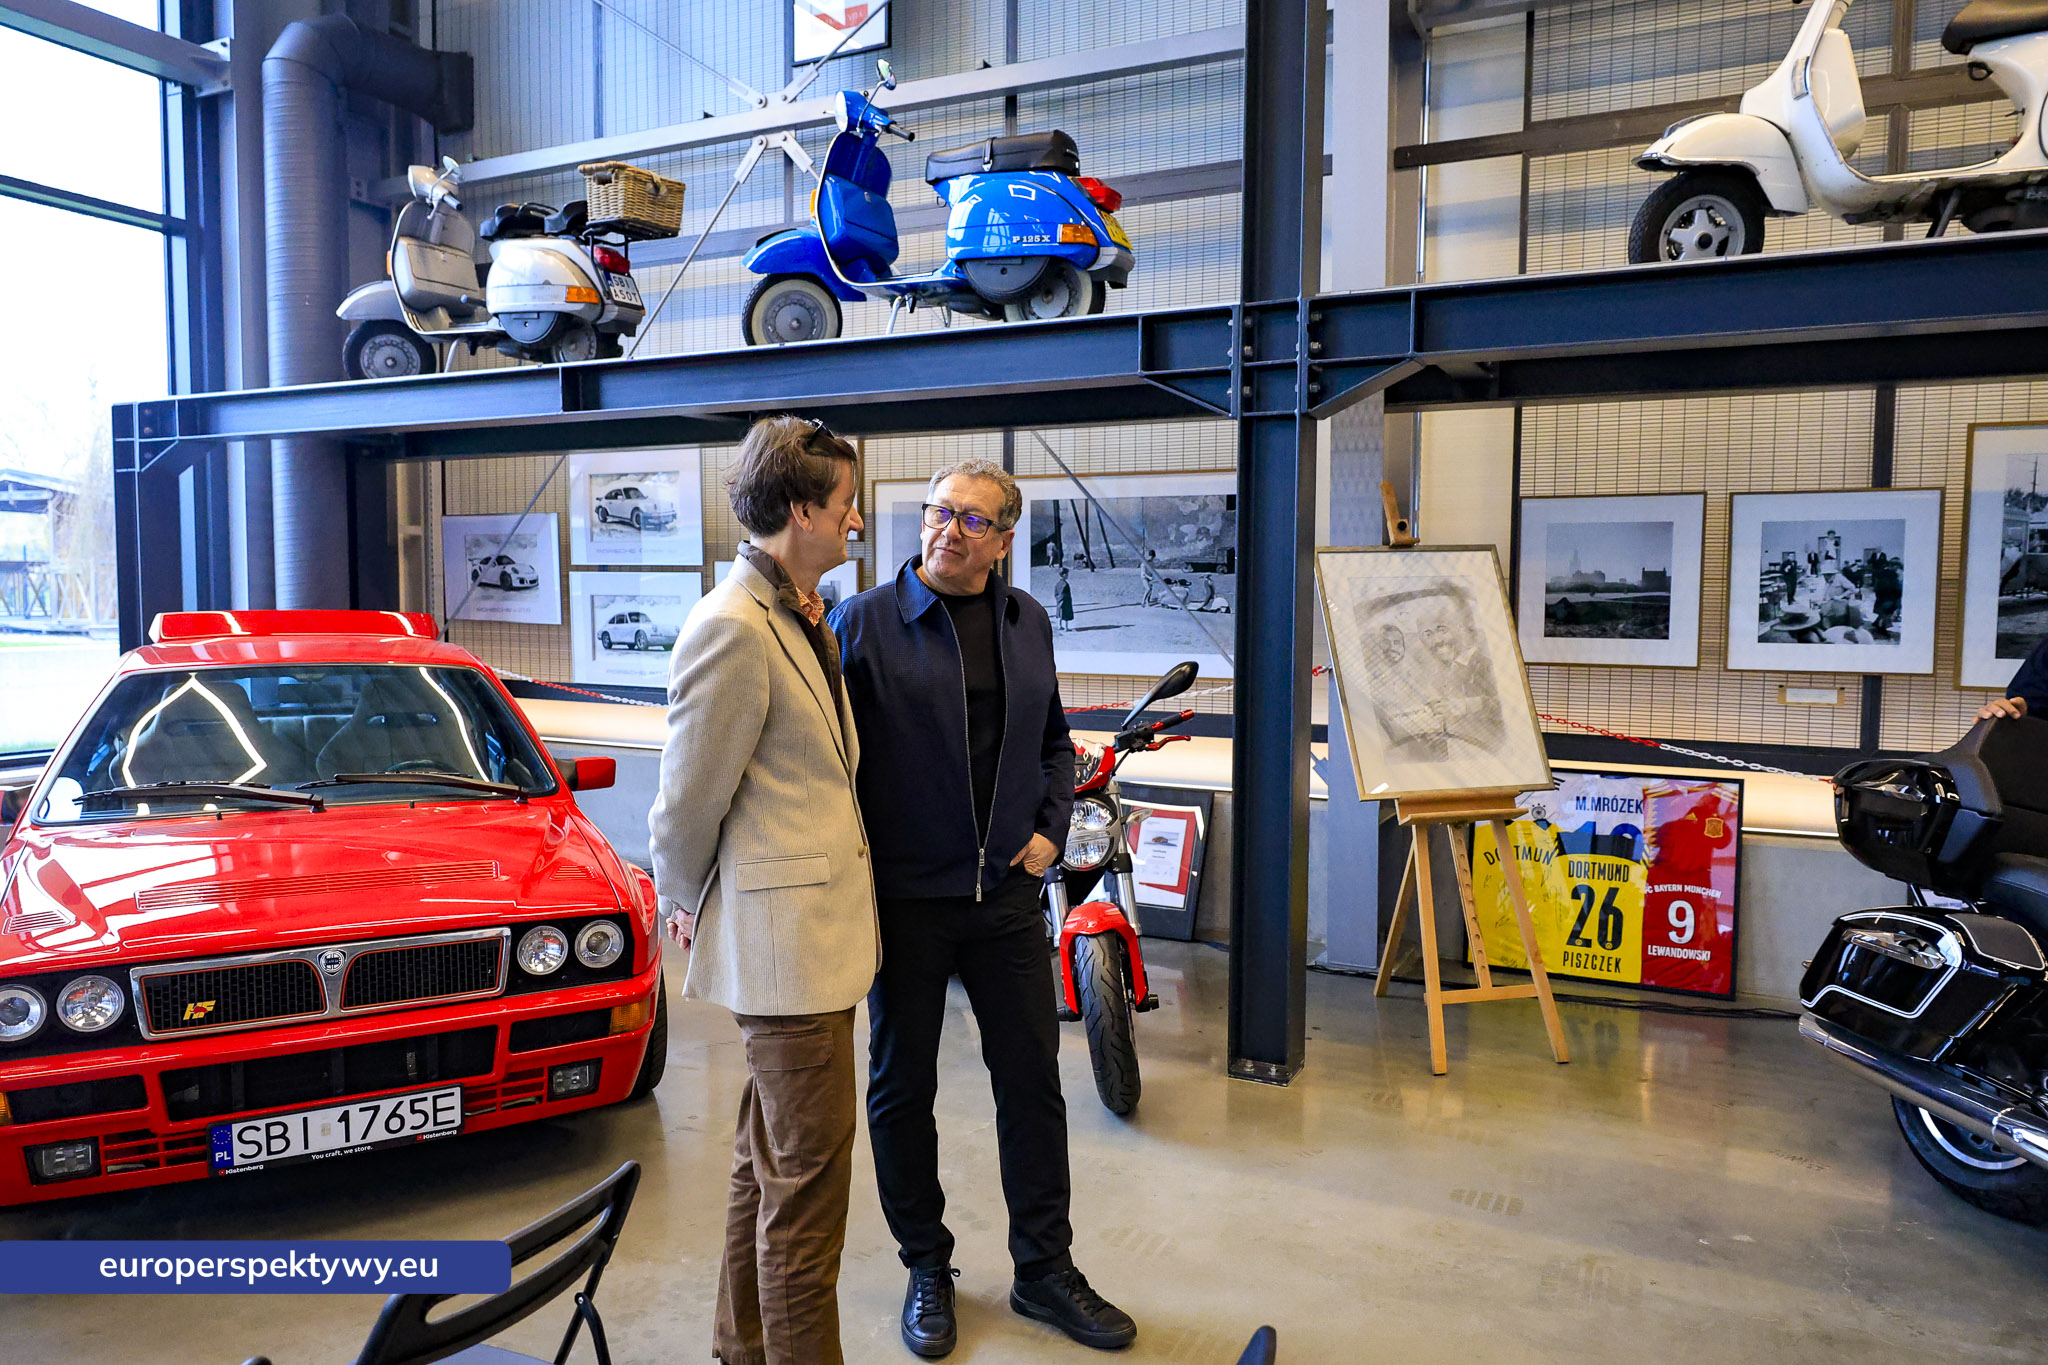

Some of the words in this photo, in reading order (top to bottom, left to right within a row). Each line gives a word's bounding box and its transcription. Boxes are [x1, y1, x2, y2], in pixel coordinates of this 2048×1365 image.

[612, 275, 630, 289] SBI
[1575, 795, 1644, 814] M.MRÓZEK
[1568, 860, 1630, 883] DORTMUND
[1654, 883, 1683, 893] BAYERN
[1566, 884, 1624, 950] 26
[1667, 899, 1695, 945] 9
[1648, 945, 1711, 962] LEWANDOWSKI
[1562, 951, 1622, 974] PISZCZEK
[236, 1116, 309, 1160] SBI
[337, 1091, 456, 1144] 1765E
[422, 1129, 457, 1141] Kistenberg
[215, 1151, 231, 1162] PL
[325, 1150, 343, 1158] craft,
[354, 1145, 373, 1153] store.
[225, 1164, 264, 1175] Kistenberg
